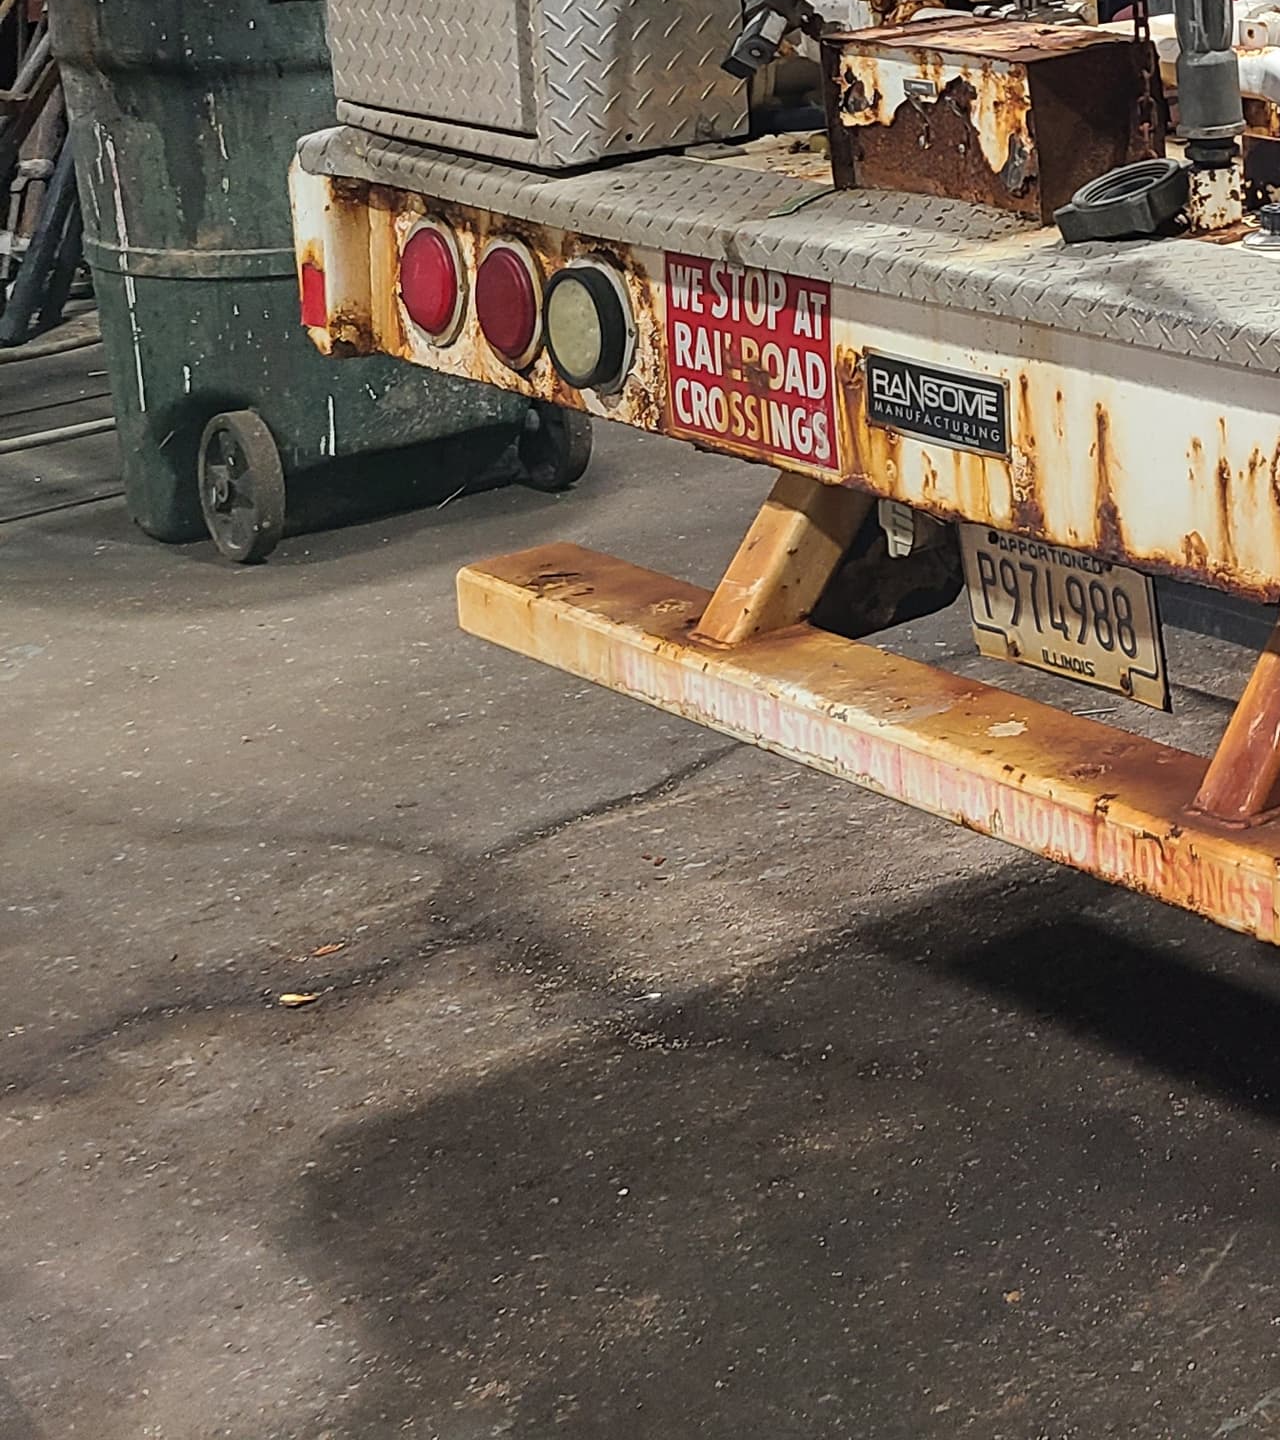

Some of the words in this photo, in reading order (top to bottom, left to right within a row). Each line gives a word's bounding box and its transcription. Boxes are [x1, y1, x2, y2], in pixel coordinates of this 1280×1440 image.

[669, 263, 704, 314] WE
[710, 260, 787, 330] STOP
[793, 290, 827, 340] AT
[674, 378, 831, 460] CROSSINGS
[872, 368, 998, 422] RANSOME
[874, 400, 1000, 442] MANUFACTURING
[999, 536, 1102, 574] APPORTIONED
[977, 551, 1137, 658] P974988
[1041, 647, 1096, 678] ILLINOIS
